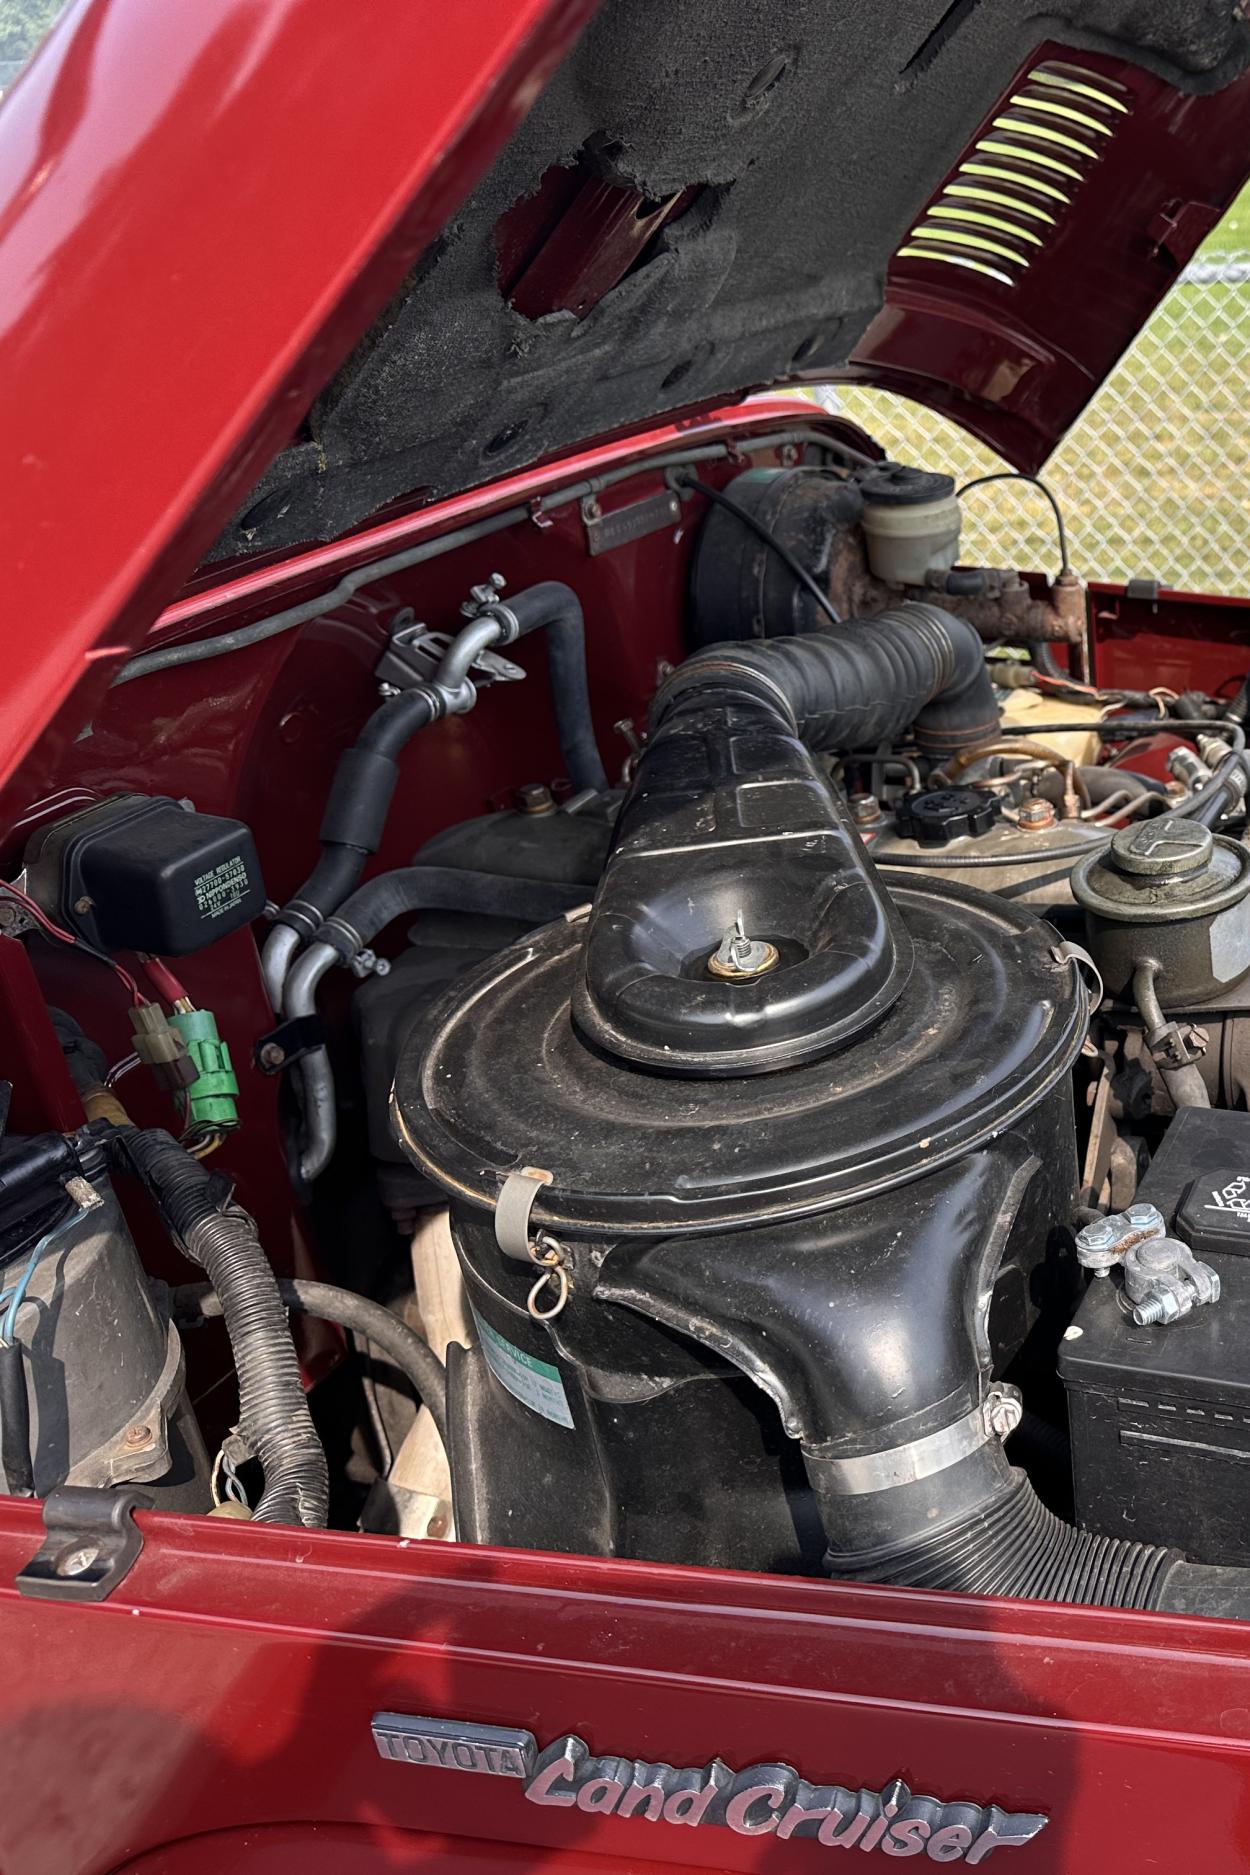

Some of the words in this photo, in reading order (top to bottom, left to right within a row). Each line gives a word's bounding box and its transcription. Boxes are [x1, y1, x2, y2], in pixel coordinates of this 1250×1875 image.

[194, 870, 214, 886] VOLTAGE
[216, 856, 240, 874] REGULATOR
[376, 1731, 524, 1776] TOYOTA
[524, 1751, 719, 1827] Land
[726, 1779, 1046, 1865] Cruiser
